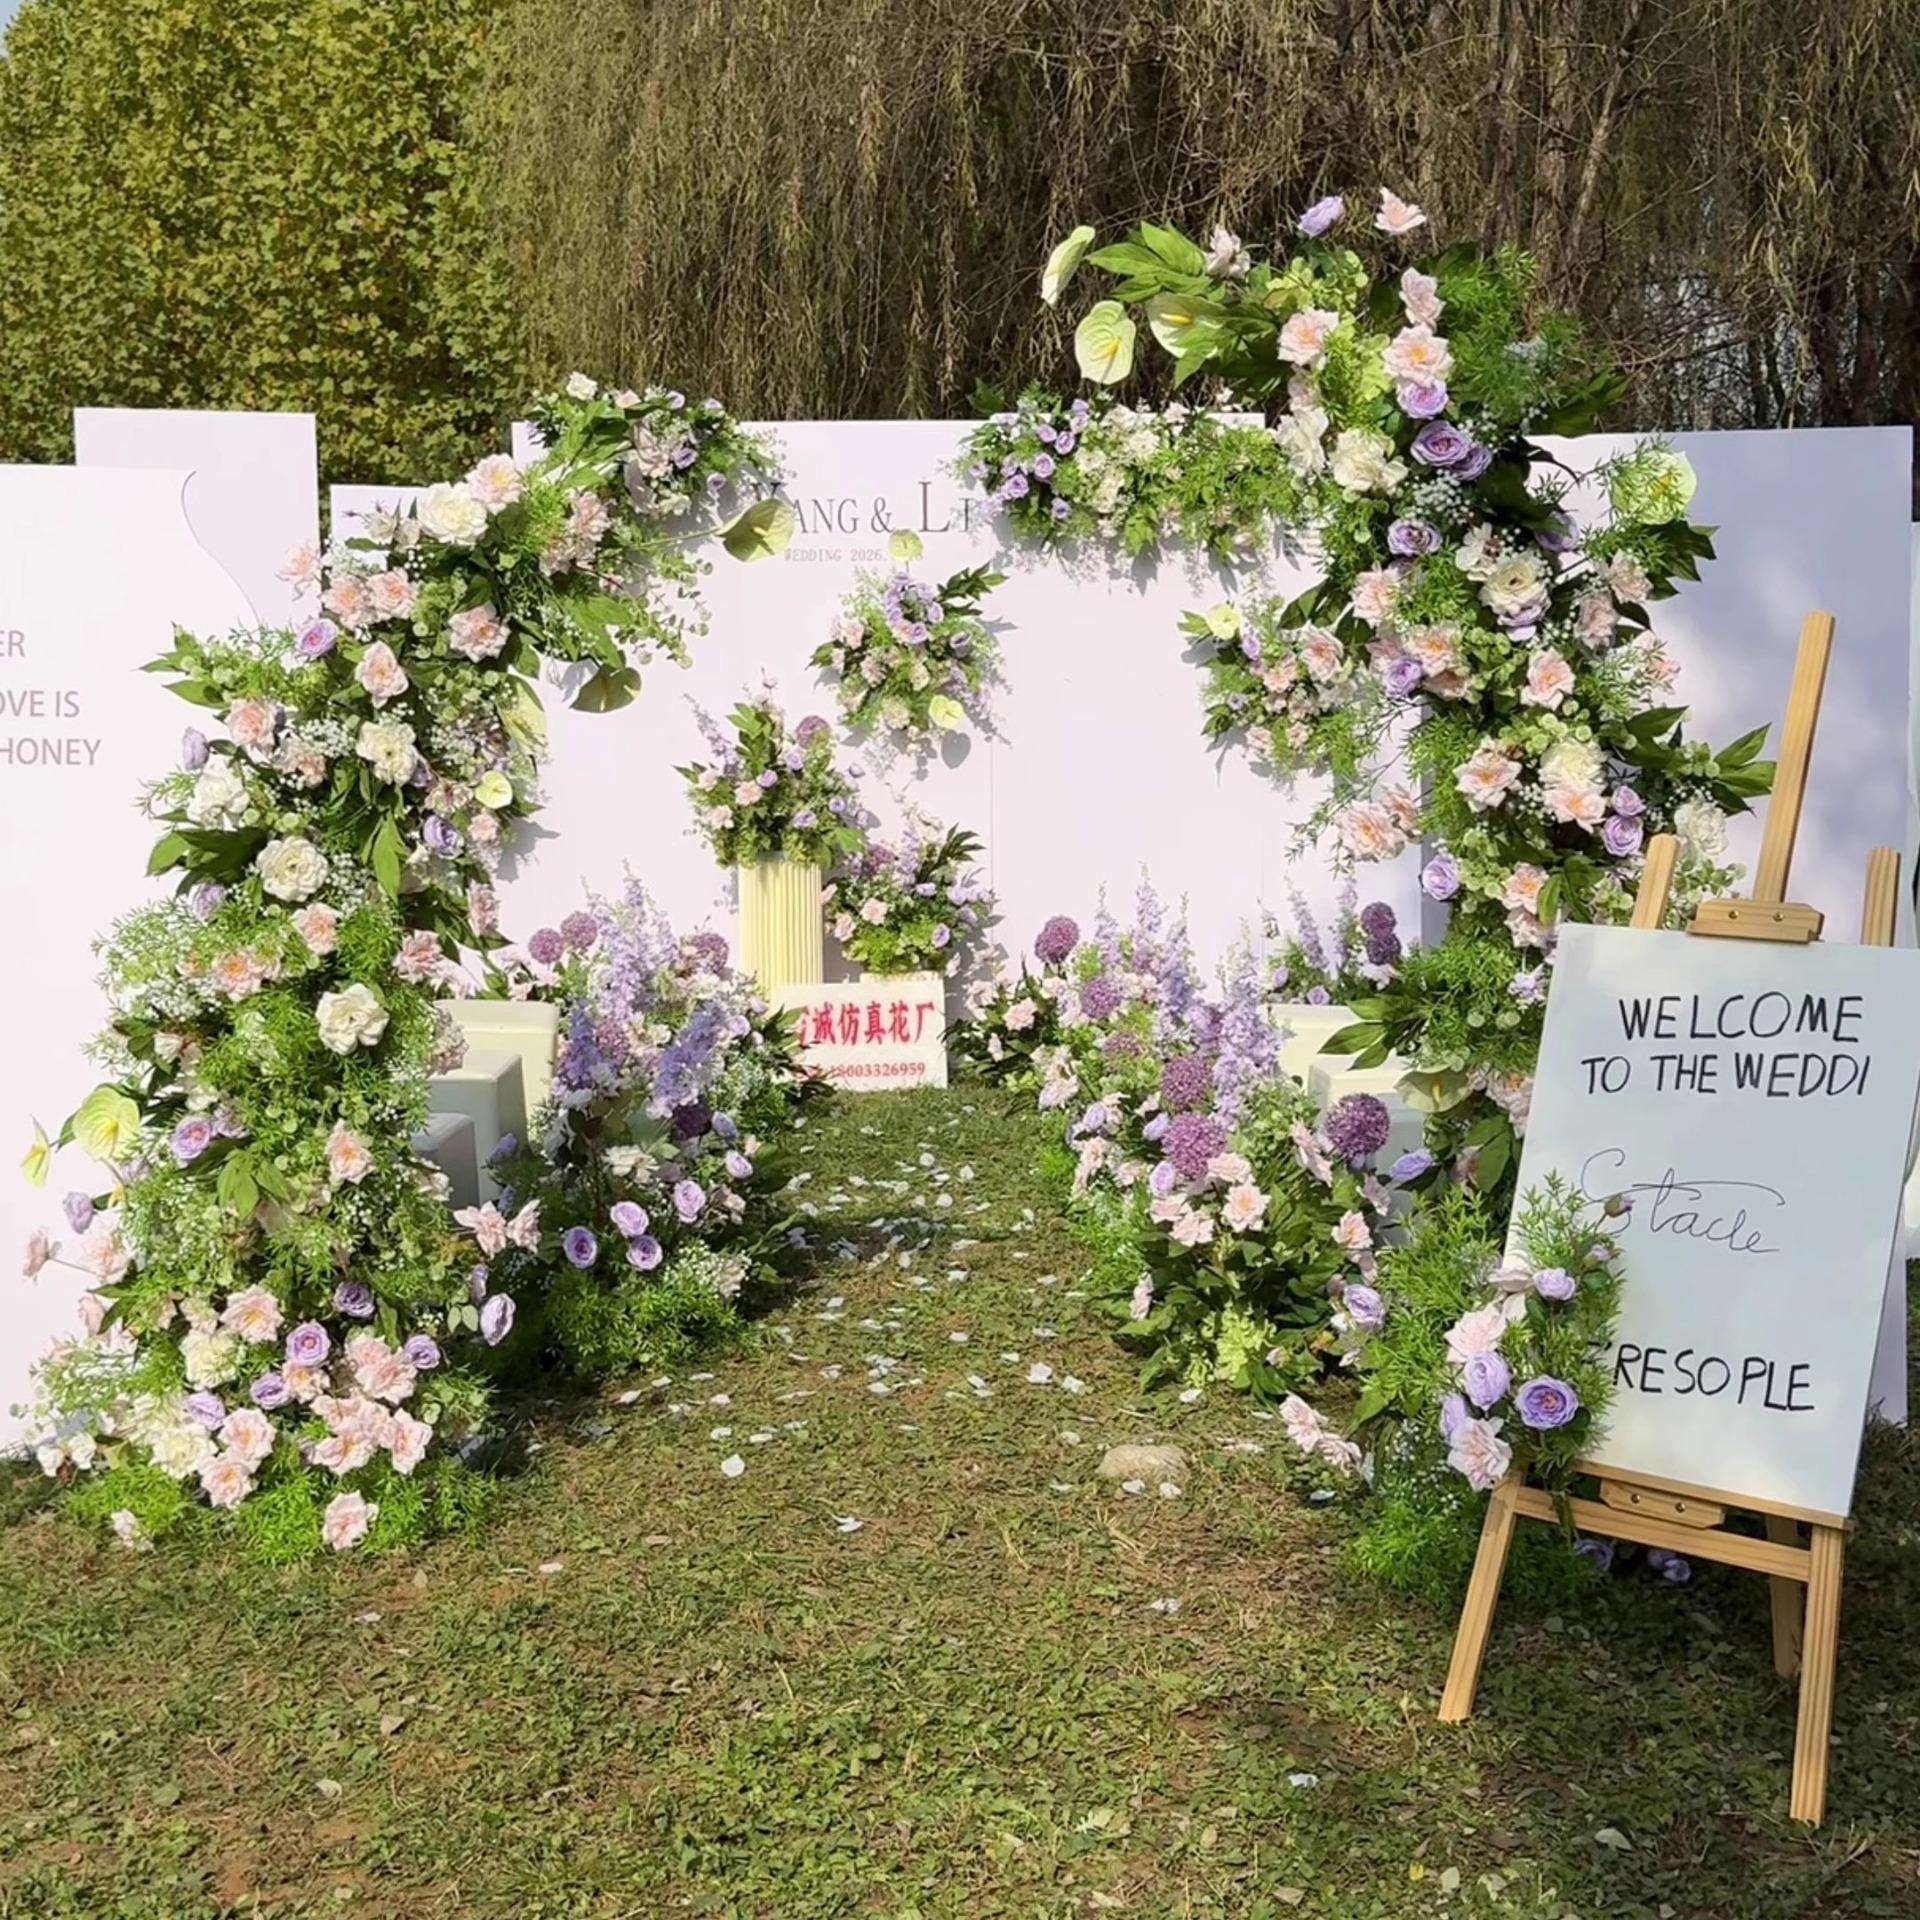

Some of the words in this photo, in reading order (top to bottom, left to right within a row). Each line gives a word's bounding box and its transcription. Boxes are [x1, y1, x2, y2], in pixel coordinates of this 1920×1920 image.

[870, 496, 894, 534] &
[0, 690, 45, 718] VE
[56, 690, 80, 718] IS
[798, 1000, 936, 1046] 诚仿真花厂
[1618, 991, 1864, 1043] WELCOME
[1581, 1056, 1632, 1095] TO
[1649, 1053, 1719, 1094] THE
[1733, 1052, 1871, 1098] WEDDI
